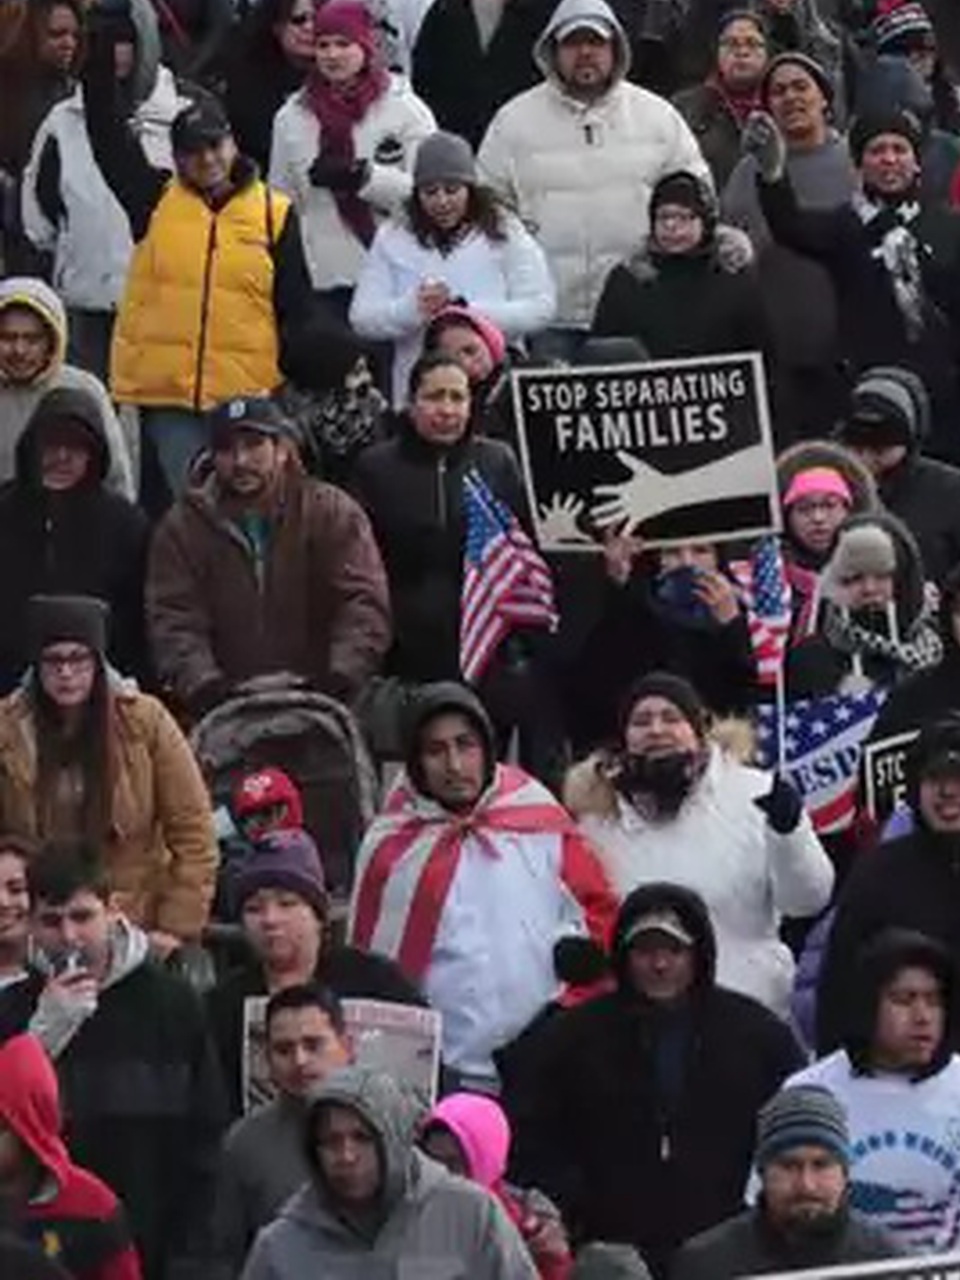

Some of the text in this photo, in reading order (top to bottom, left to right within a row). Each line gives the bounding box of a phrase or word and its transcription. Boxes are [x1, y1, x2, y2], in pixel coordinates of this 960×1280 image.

[527, 369, 747, 412] STOP SEPARATING
[554, 402, 729, 453] FAMILIES
